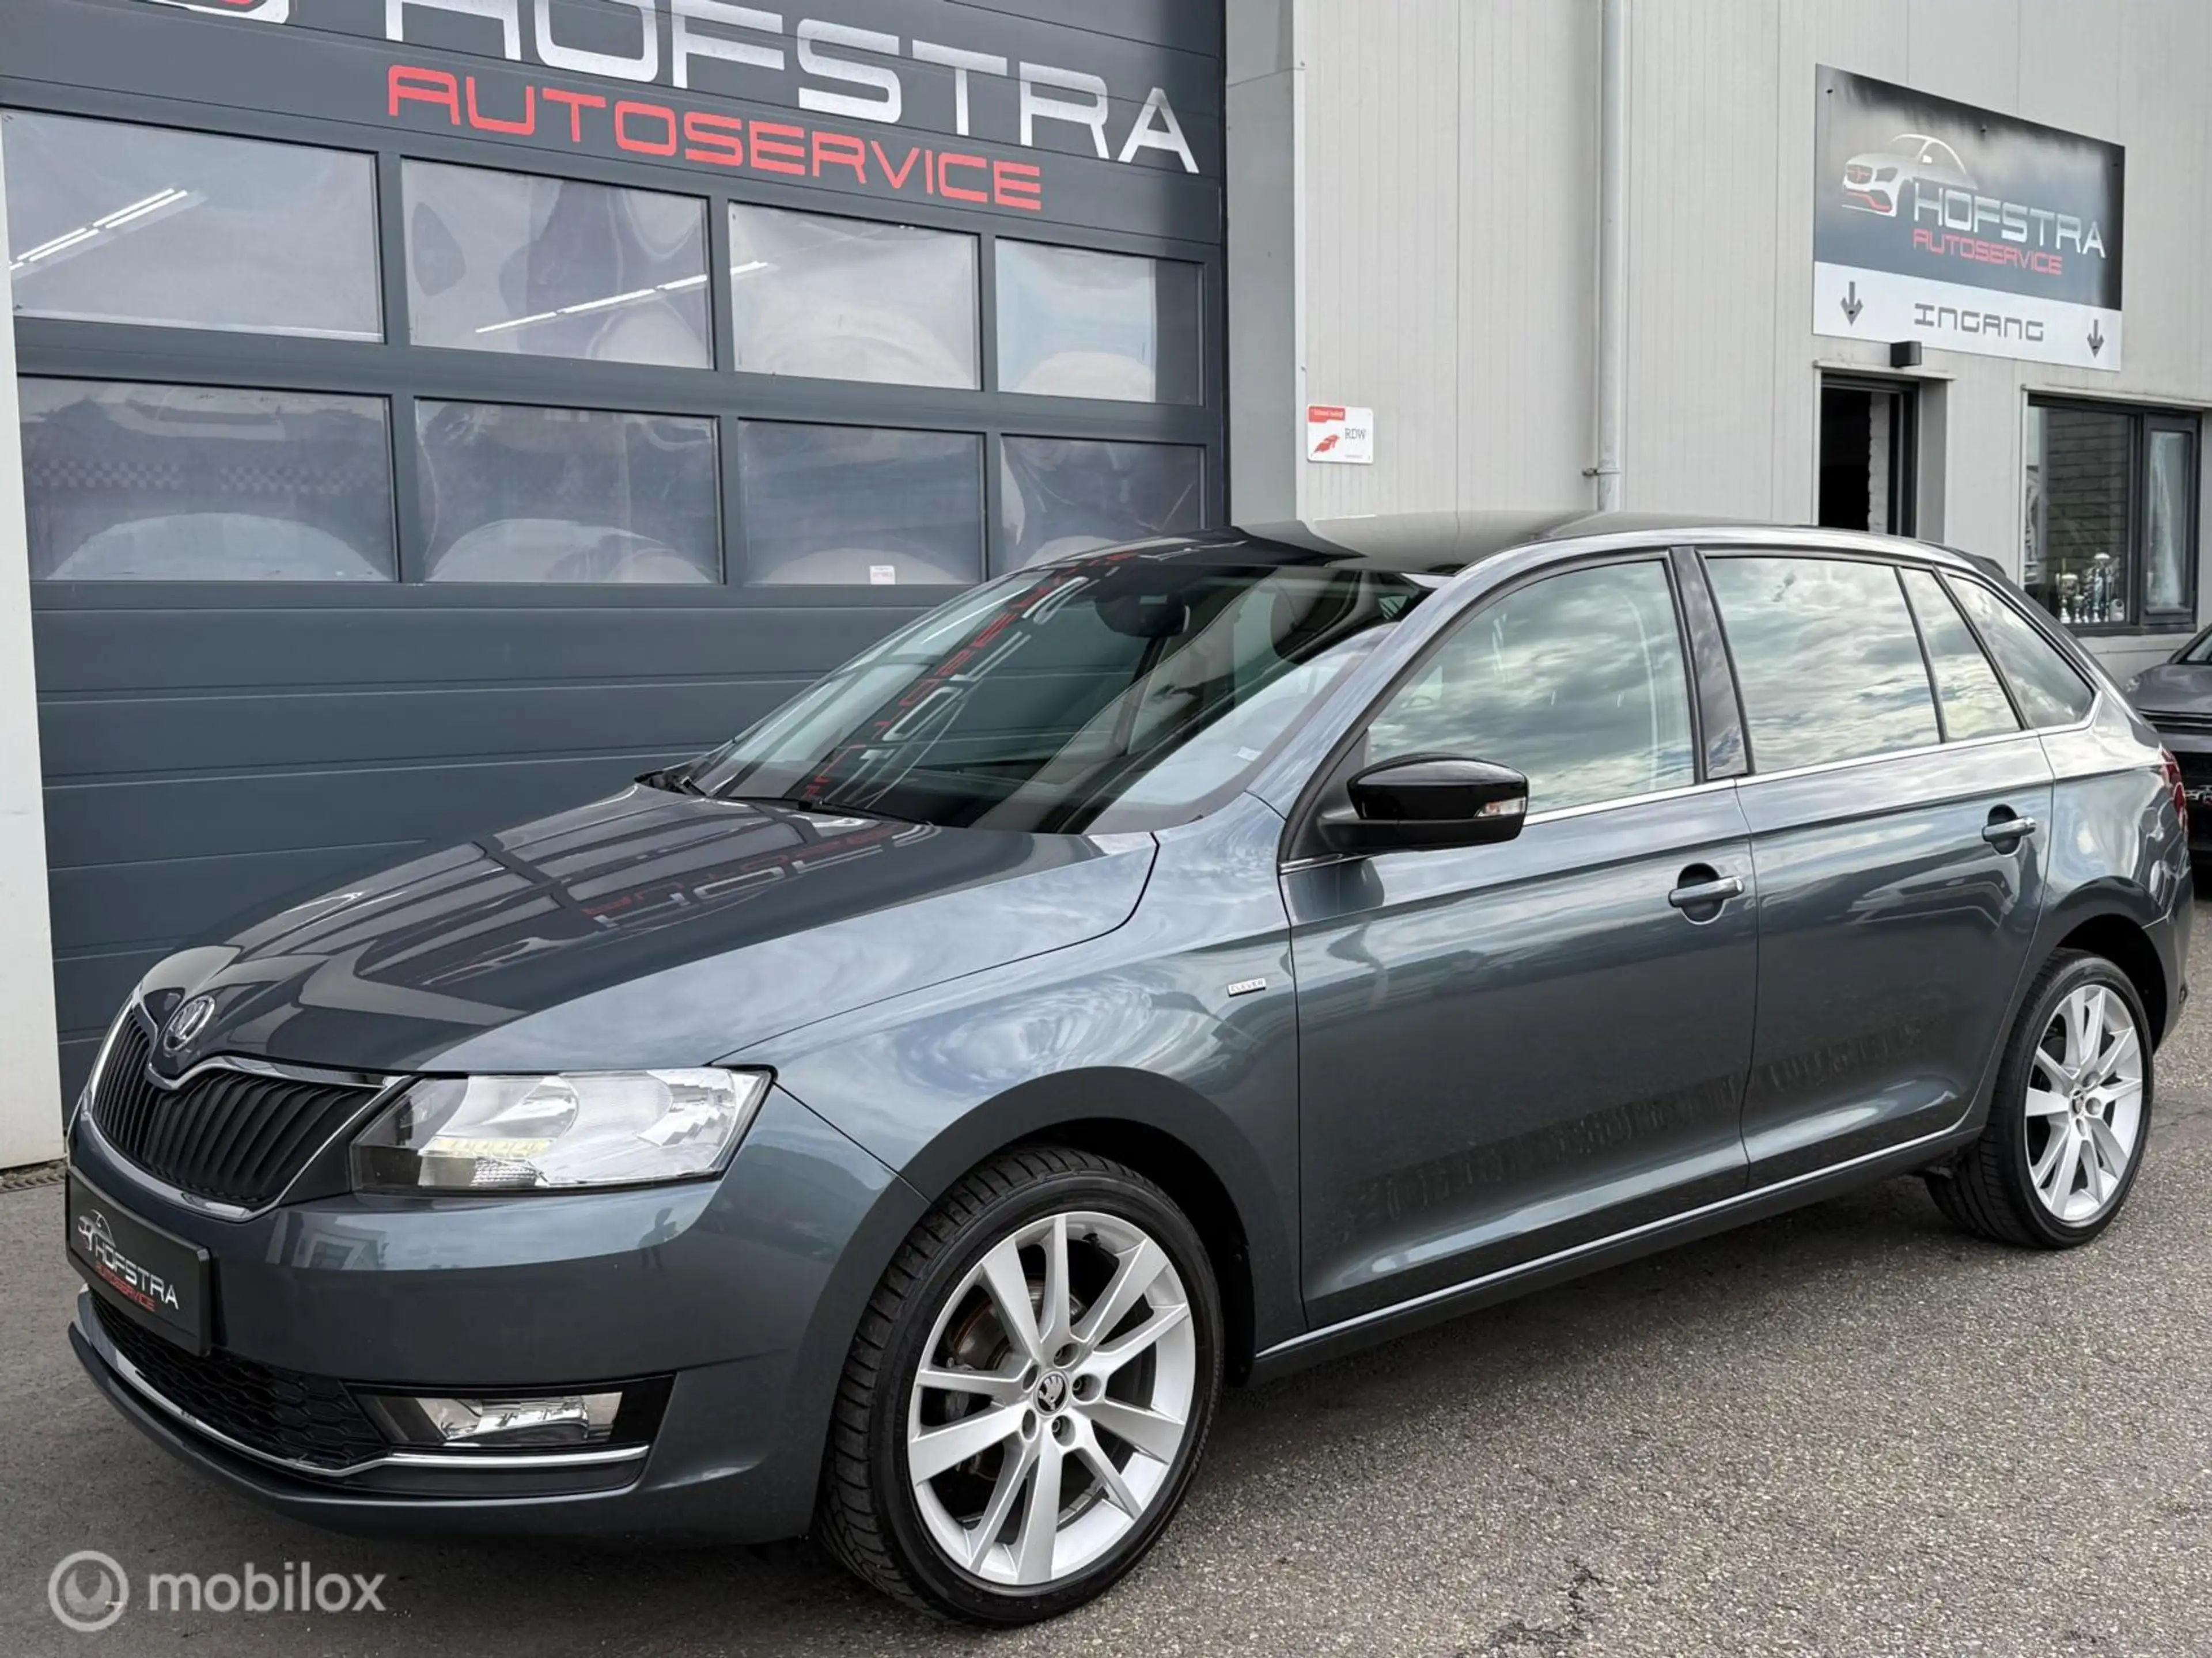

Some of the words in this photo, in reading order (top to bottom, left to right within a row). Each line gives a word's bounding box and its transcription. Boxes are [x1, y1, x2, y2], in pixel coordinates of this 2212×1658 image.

[388, 65, 1041, 210] AUTOSERVICE
[1912, 228, 2063, 275] AUTOSERVICE
[1914, 182, 2106, 259] HOFSTRA
[1914, 302, 2044, 342] INGANG
[95, 1236, 179, 1310] HOFSTRA
